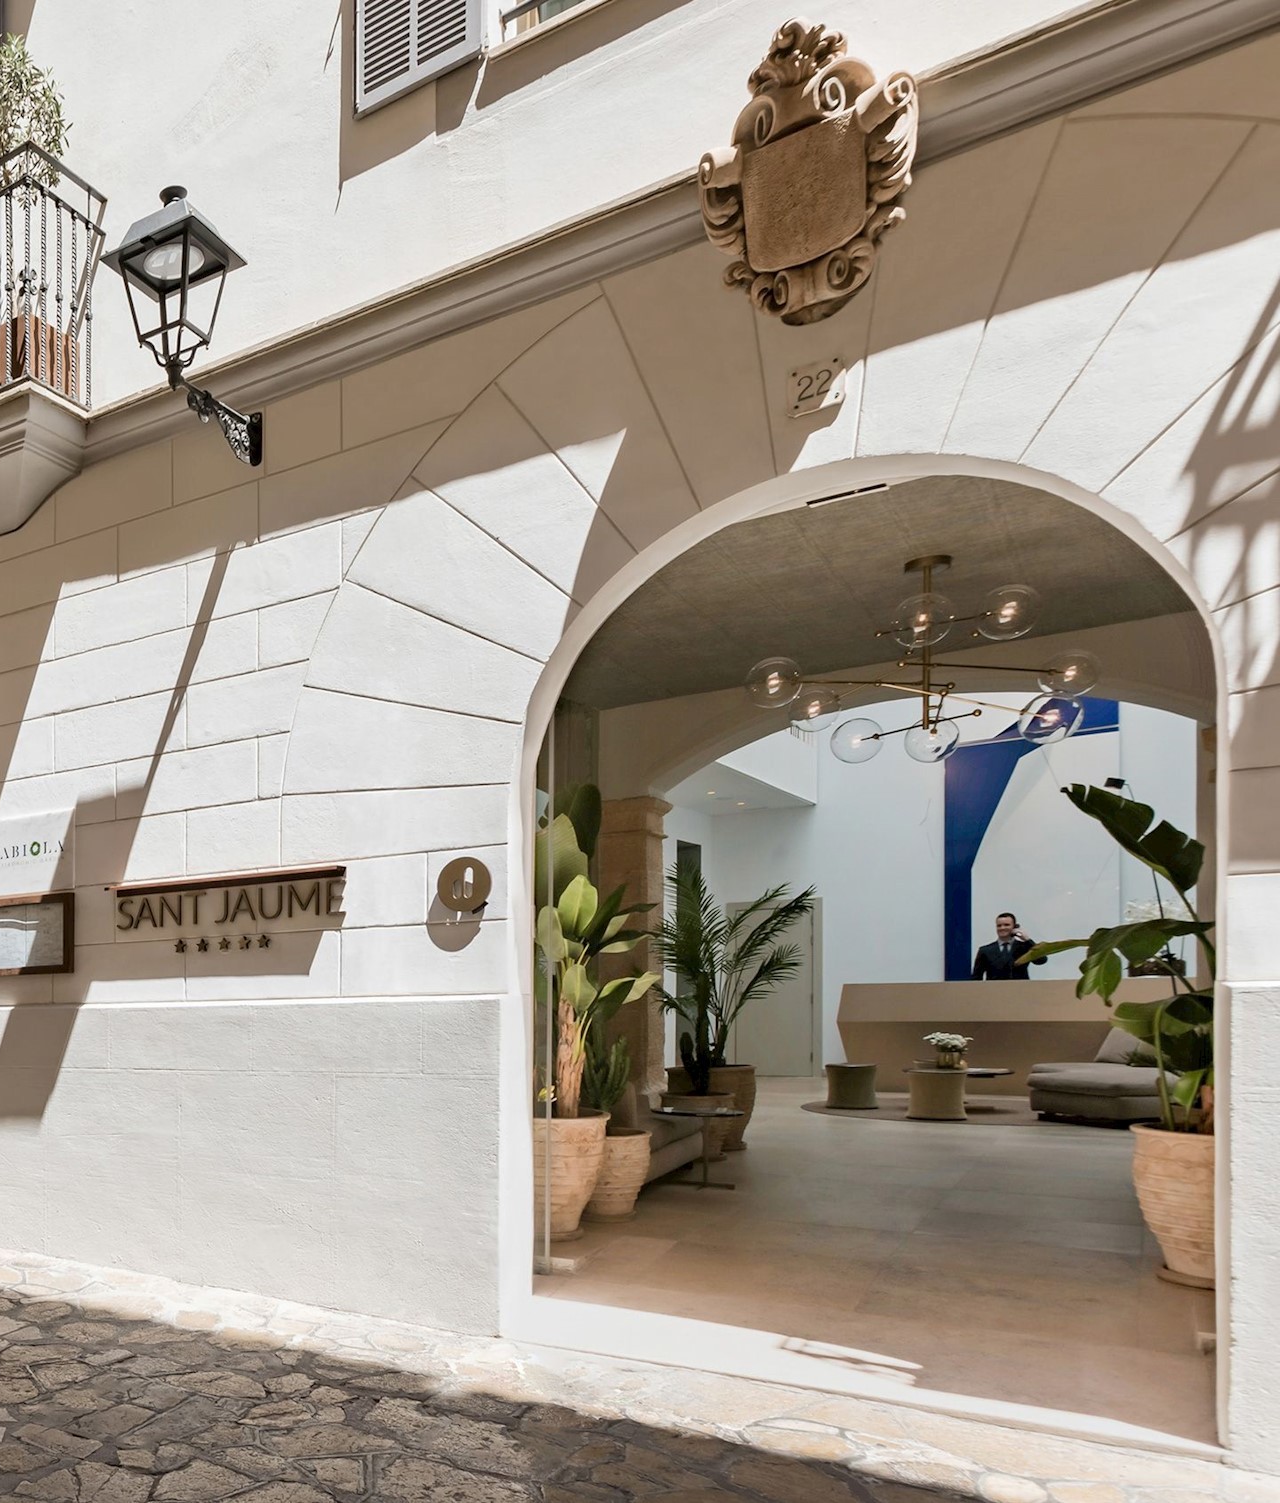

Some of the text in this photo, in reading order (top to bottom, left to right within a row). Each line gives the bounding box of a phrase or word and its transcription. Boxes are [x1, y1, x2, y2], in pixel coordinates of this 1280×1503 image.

[797, 369, 832, 402] 22
[116, 879, 347, 931] SANT JAUME
